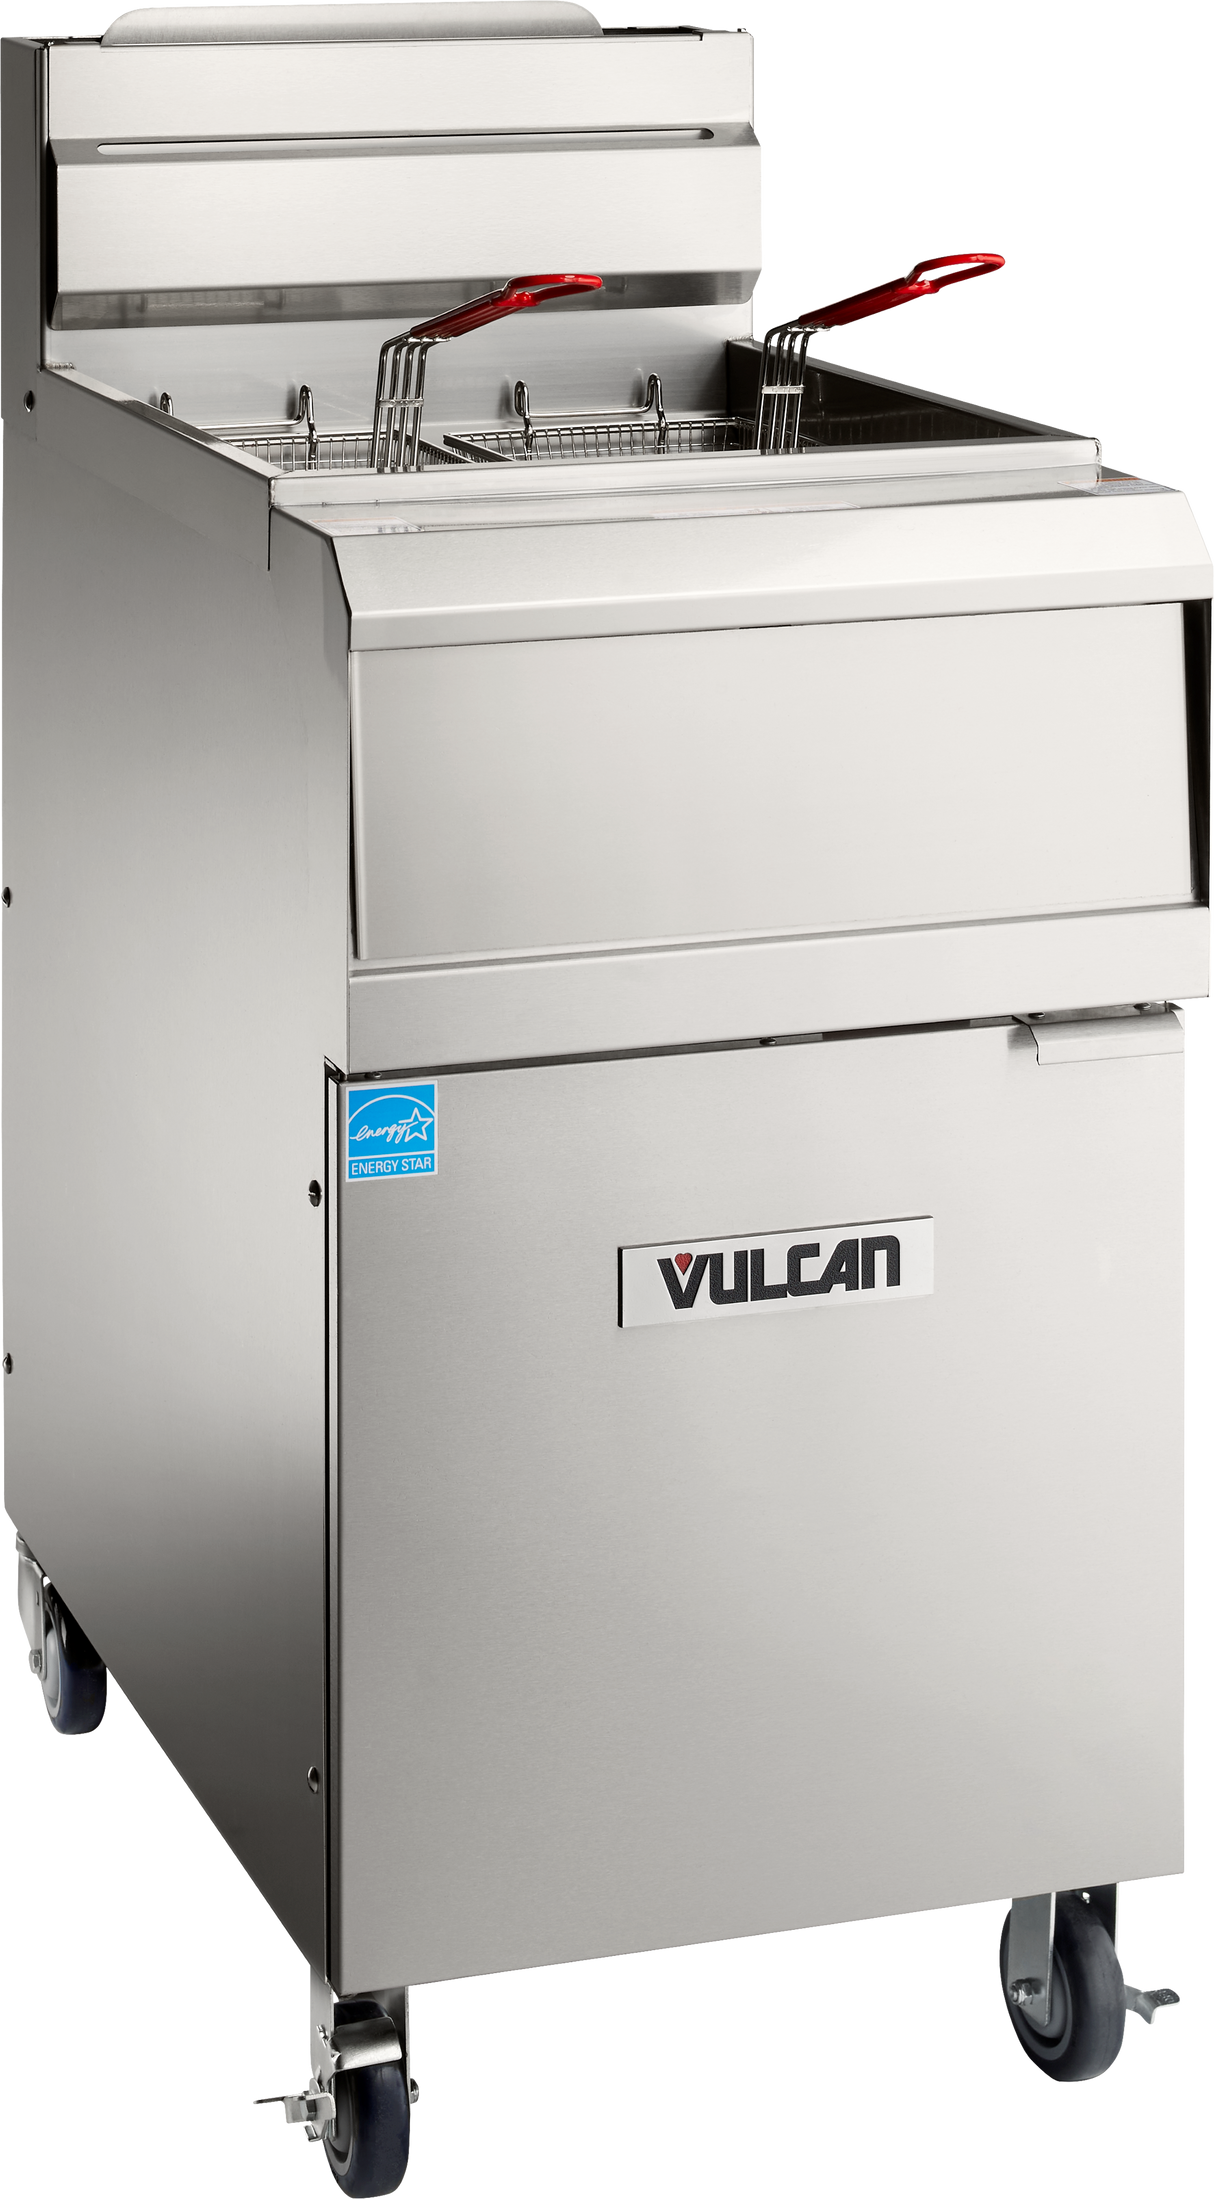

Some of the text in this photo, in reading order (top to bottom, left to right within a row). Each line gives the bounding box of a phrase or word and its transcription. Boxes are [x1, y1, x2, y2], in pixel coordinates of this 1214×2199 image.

[349, 1122, 410, 1144] energy
[351, 1156, 432, 1175] ENERGY STAR
[656, 1234, 901, 1310] VULCAN
